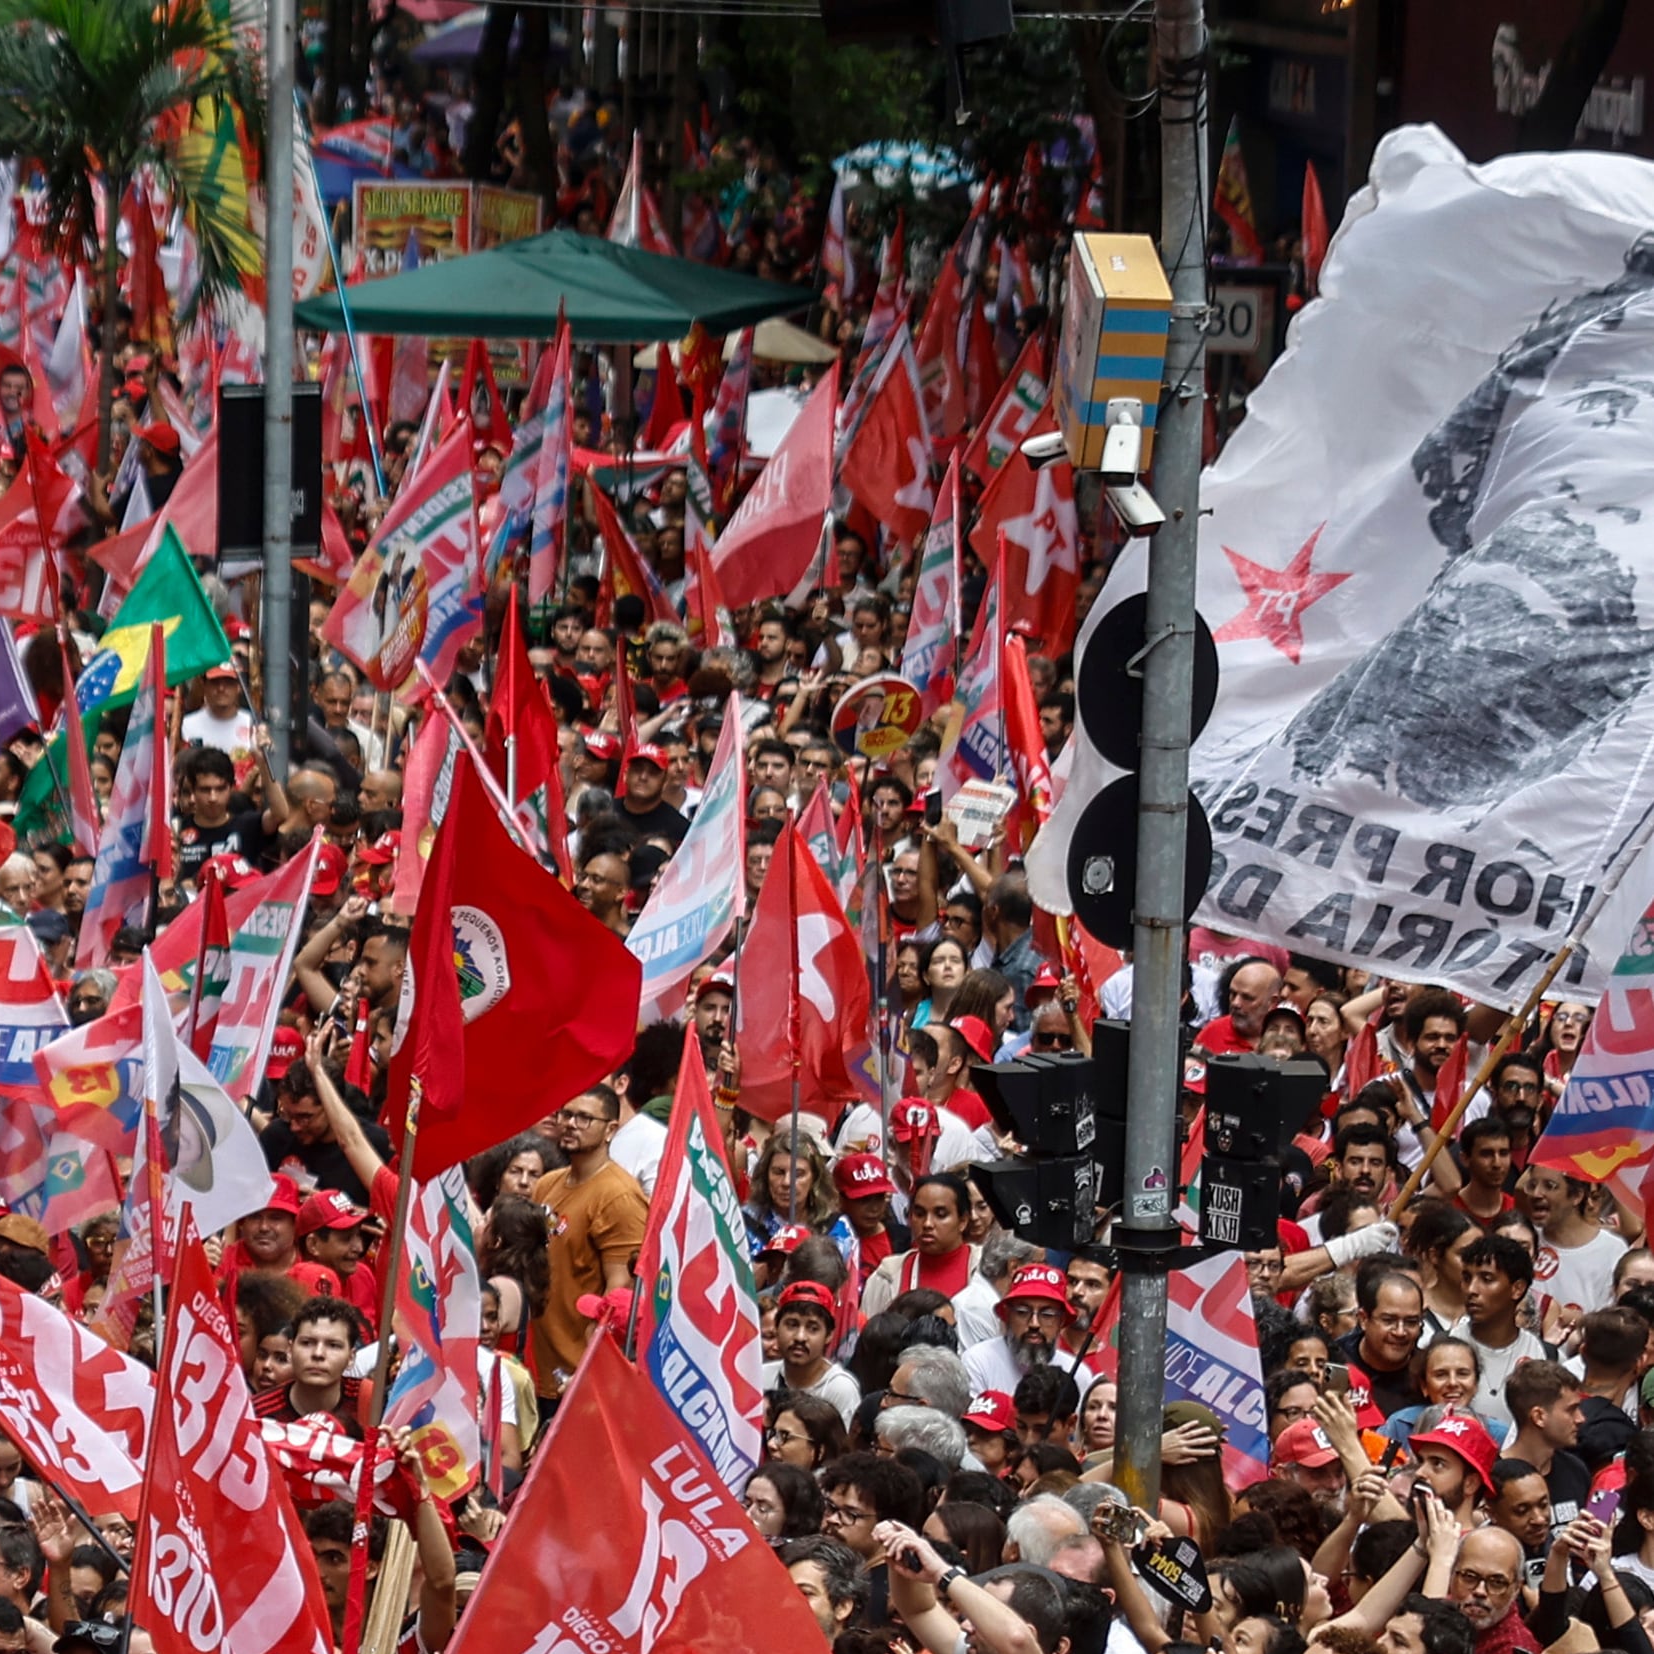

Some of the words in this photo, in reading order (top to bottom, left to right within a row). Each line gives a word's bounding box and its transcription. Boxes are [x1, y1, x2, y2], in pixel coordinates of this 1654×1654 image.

[882, 692, 916, 724] 13
[456, 910, 499, 953] PEQUENOS
[852, 1163, 884, 1181] LULA
[1204, 1213, 1241, 1244] KUSH
[191, 1290, 233, 1347] DIEGO
[649, 1445, 749, 1560] LULA
[1150, 1550, 1182, 1583] 5044
